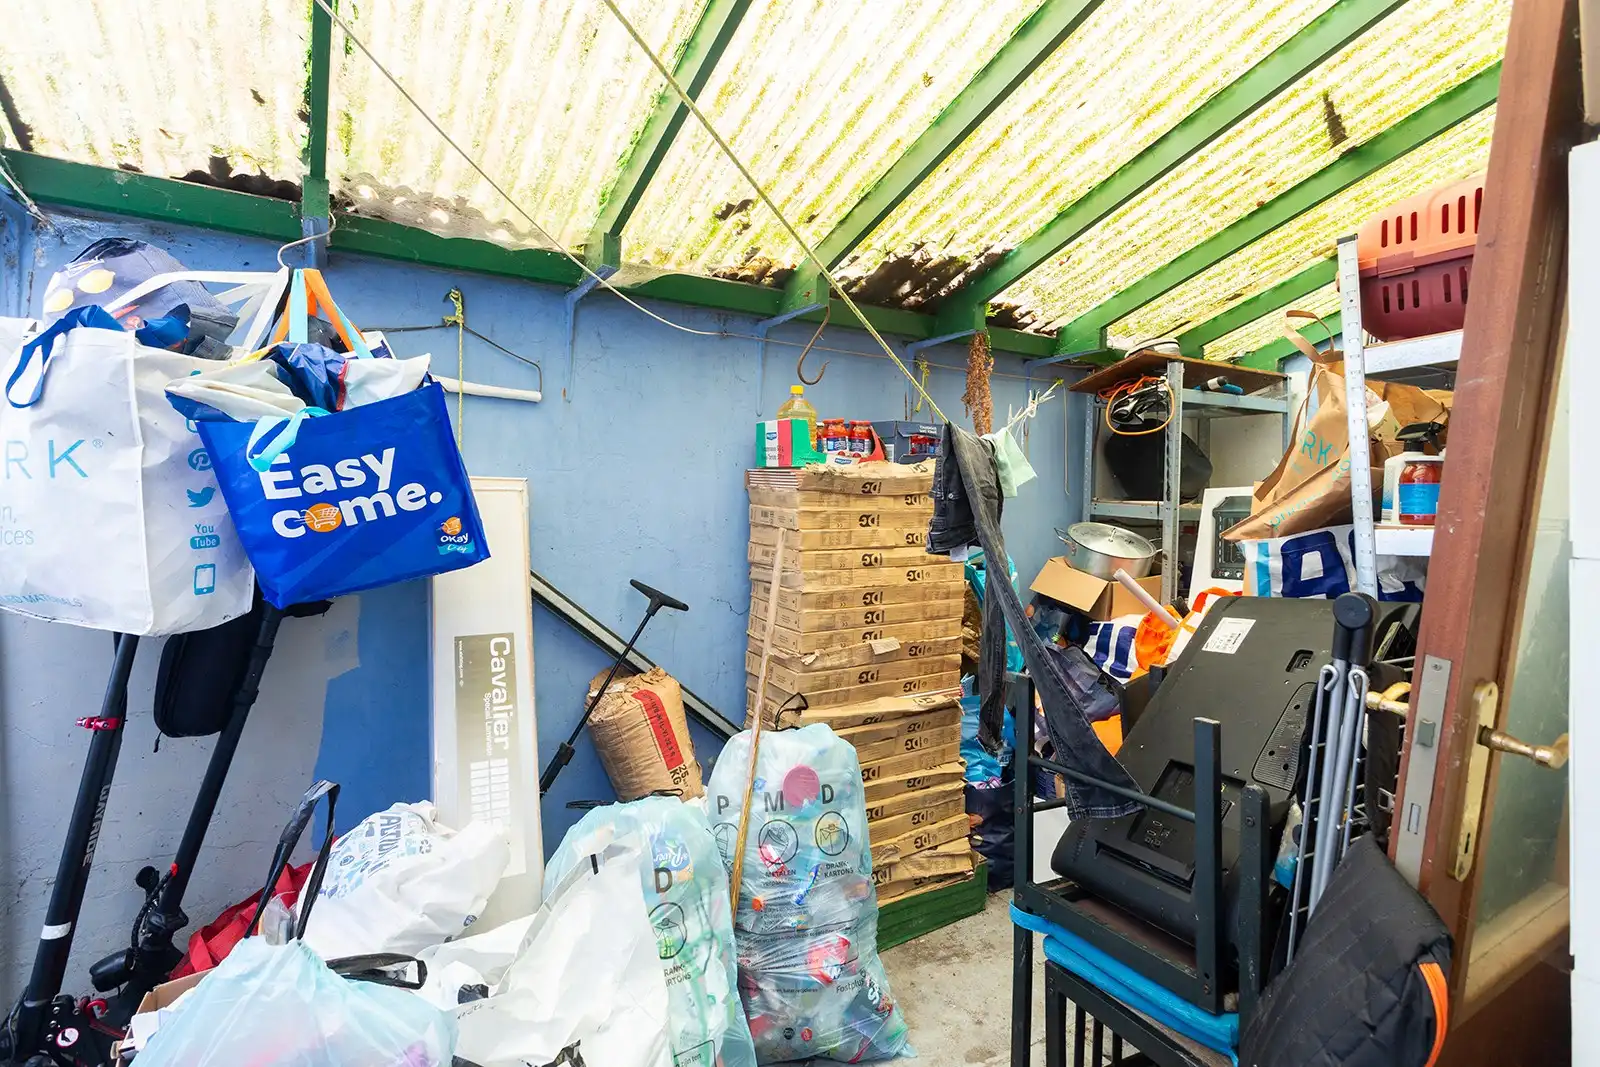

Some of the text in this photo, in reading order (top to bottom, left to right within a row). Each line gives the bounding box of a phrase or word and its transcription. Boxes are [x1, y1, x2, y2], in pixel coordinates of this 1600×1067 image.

[253, 448, 395, 500] Easy
[194, 524, 214, 533] You
[194, 537, 217, 547] Tube
[490, 637, 512, 750] Cavalier
[717, 784, 834, 815] P M D
[654, 867, 673, 894] D
[823, 868, 854, 878] KARTONS
